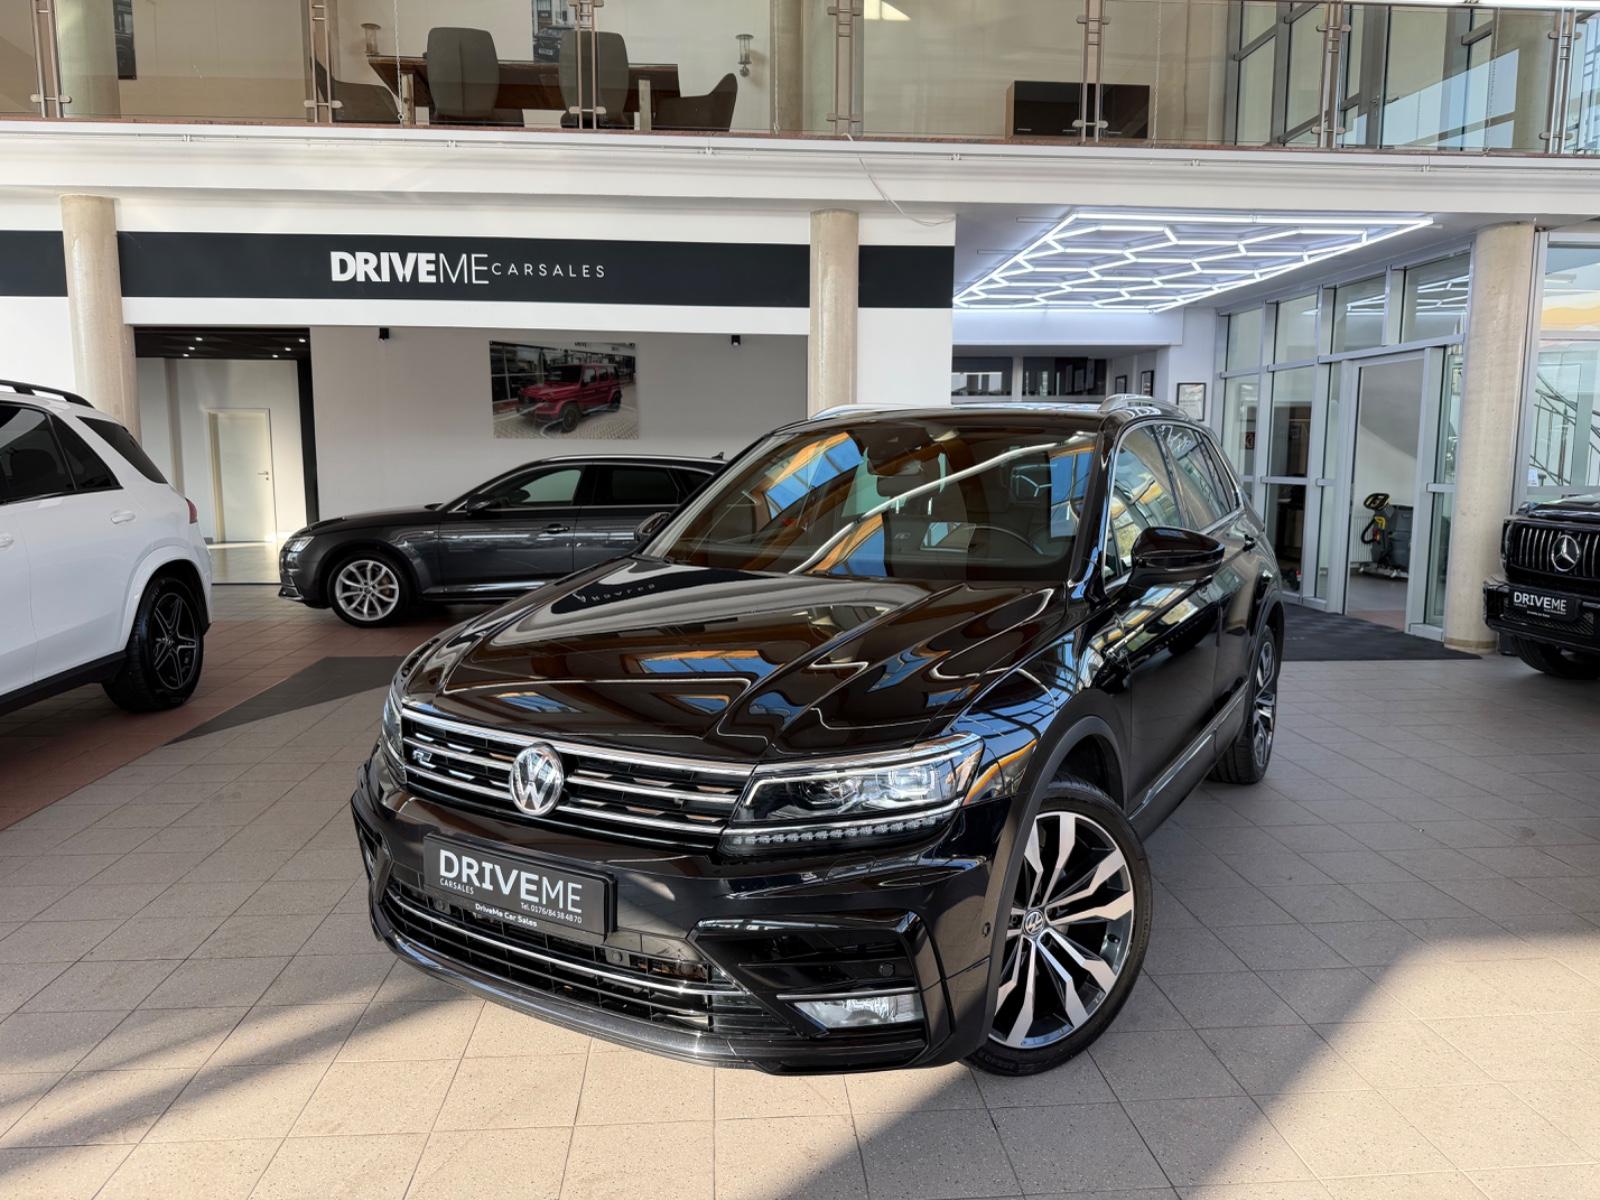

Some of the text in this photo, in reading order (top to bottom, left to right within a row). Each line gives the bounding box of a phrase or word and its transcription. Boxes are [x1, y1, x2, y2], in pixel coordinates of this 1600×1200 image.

[330, 251, 605, 284] DRIVEME CARSALES
[1514, 592, 1567, 611] DRIVEME
[439, 849, 582, 913] DRIVEME
[440, 878, 474, 894] CARSALES
[517, 915, 538, 927] Sales
